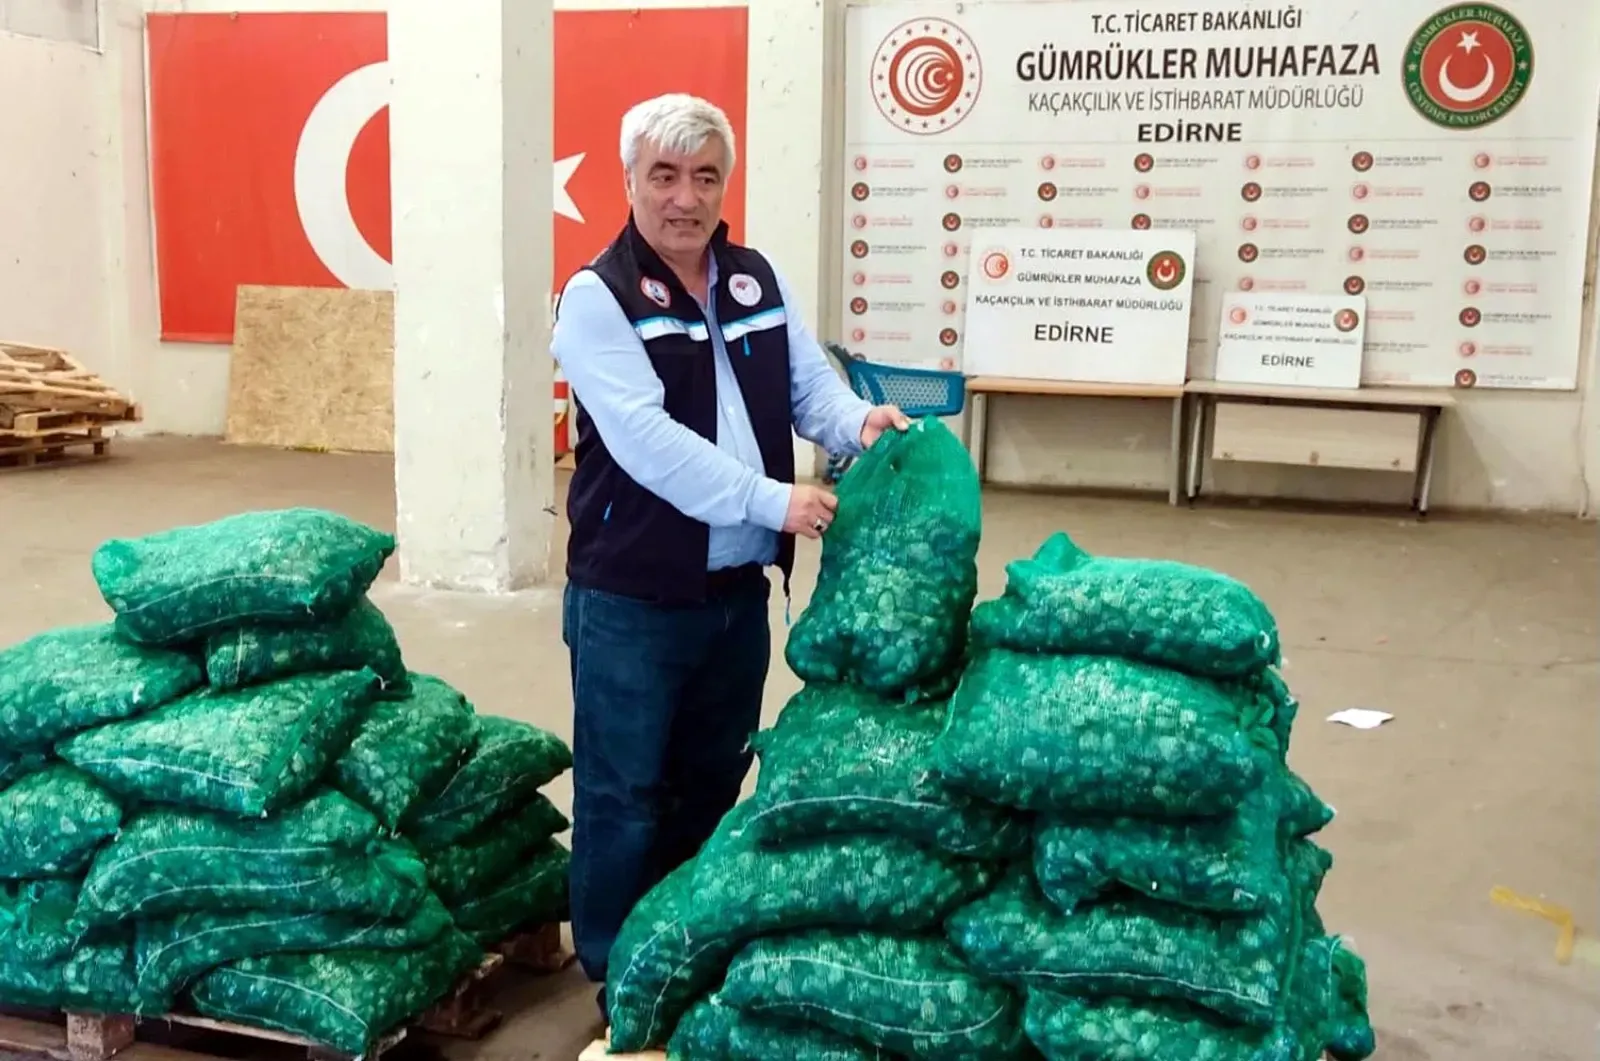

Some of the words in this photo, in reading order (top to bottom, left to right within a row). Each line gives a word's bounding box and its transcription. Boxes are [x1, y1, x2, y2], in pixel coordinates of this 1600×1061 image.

[1092, 14, 1121, 34] T.C.
[1124, 10, 1200, 33] TİCARET
[1202, 6, 1302, 31] BAKANLIĞI
[1016, 43, 1198, 81] GÜMRÜKLER
[1205, 44, 1380, 79] MUHAFAZA
[1029, 90, 1121, 116] KAÇAKÇILIK
[1125, 92, 1145, 111] VE
[1149, 86, 1245, 111] İSTİHBARAT
[1249, 84, 1364, 110] MÜDÜRLÜĞÜ
[1137, 119, 1242, 143] EDİRNE
[1041, 247, 1084, 260] TİCARET
[1086, 249, 1143, 261] BAKANLIĞI
[1016, 271, 1081, 284] GÜMRÜKLER
[1084, 274, 1141, 286] MUHAFAZA
[975, 295, 1035, 307] KAÇAKÇILIK
[1038, 297, 1051, 307] VE
[1053, 296, 1112, 308] İSTİHBARAT
[1116, 298, 1183, 311] MÜDÜRLÜĞÜ
[1034, 321, 1114, 344] EDİRNE
[1261, 352, 1314, 367] EDİRNE
